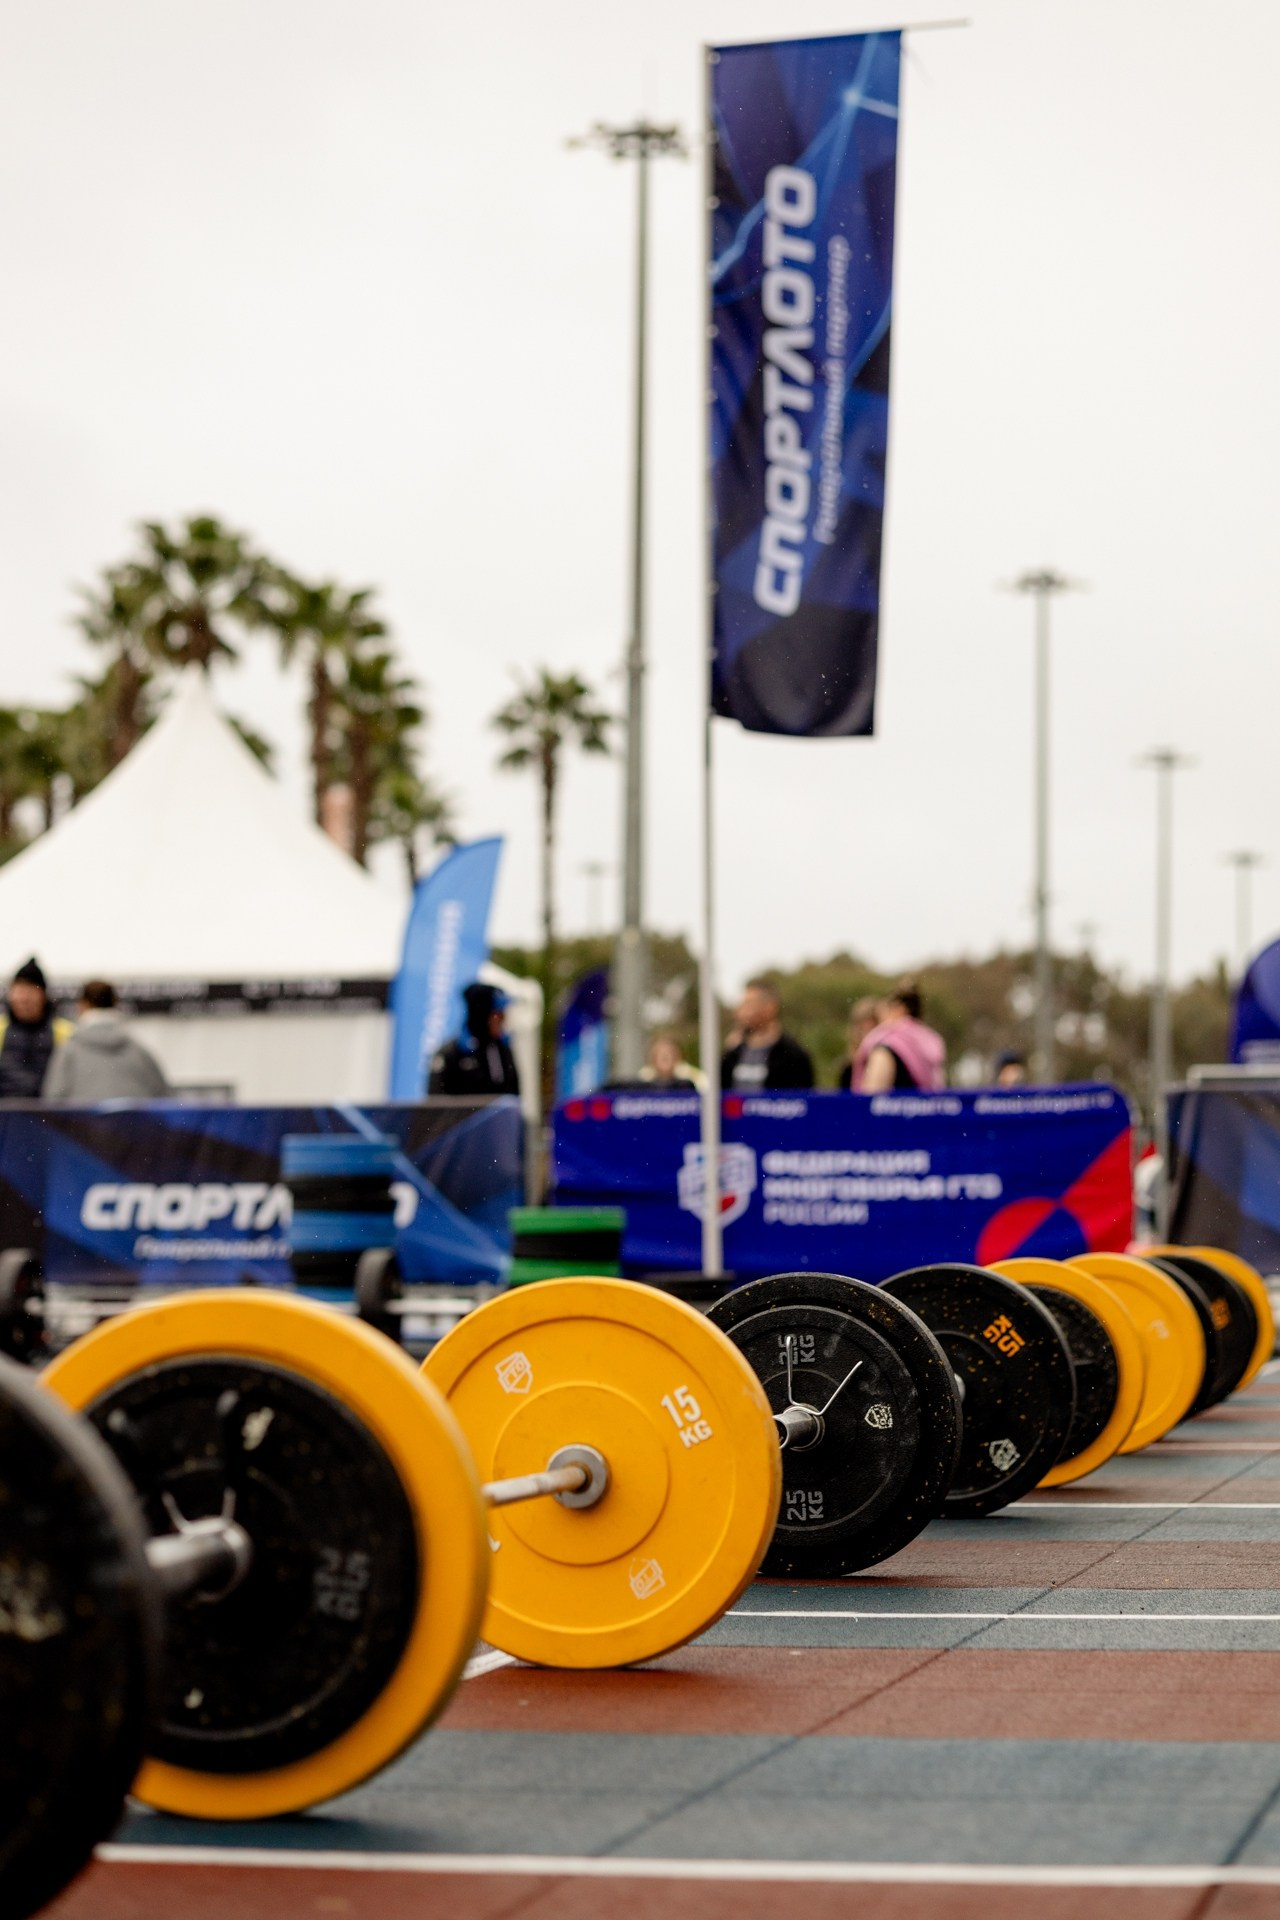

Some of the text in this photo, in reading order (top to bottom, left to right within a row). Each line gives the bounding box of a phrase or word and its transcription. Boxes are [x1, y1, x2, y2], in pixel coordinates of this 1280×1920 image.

[753, 165, 818, 617] СПОРТЛОТО
[982, 1314, 1013, 1344] KG
[997, 1329, 1026, 1358] 15
[799, 1333, 816, 1364] KG
[660, 1384, 702, 1429] 15
[679, 1419, 714, 1449] KG
[808, 1489, 825, 1520] KG
